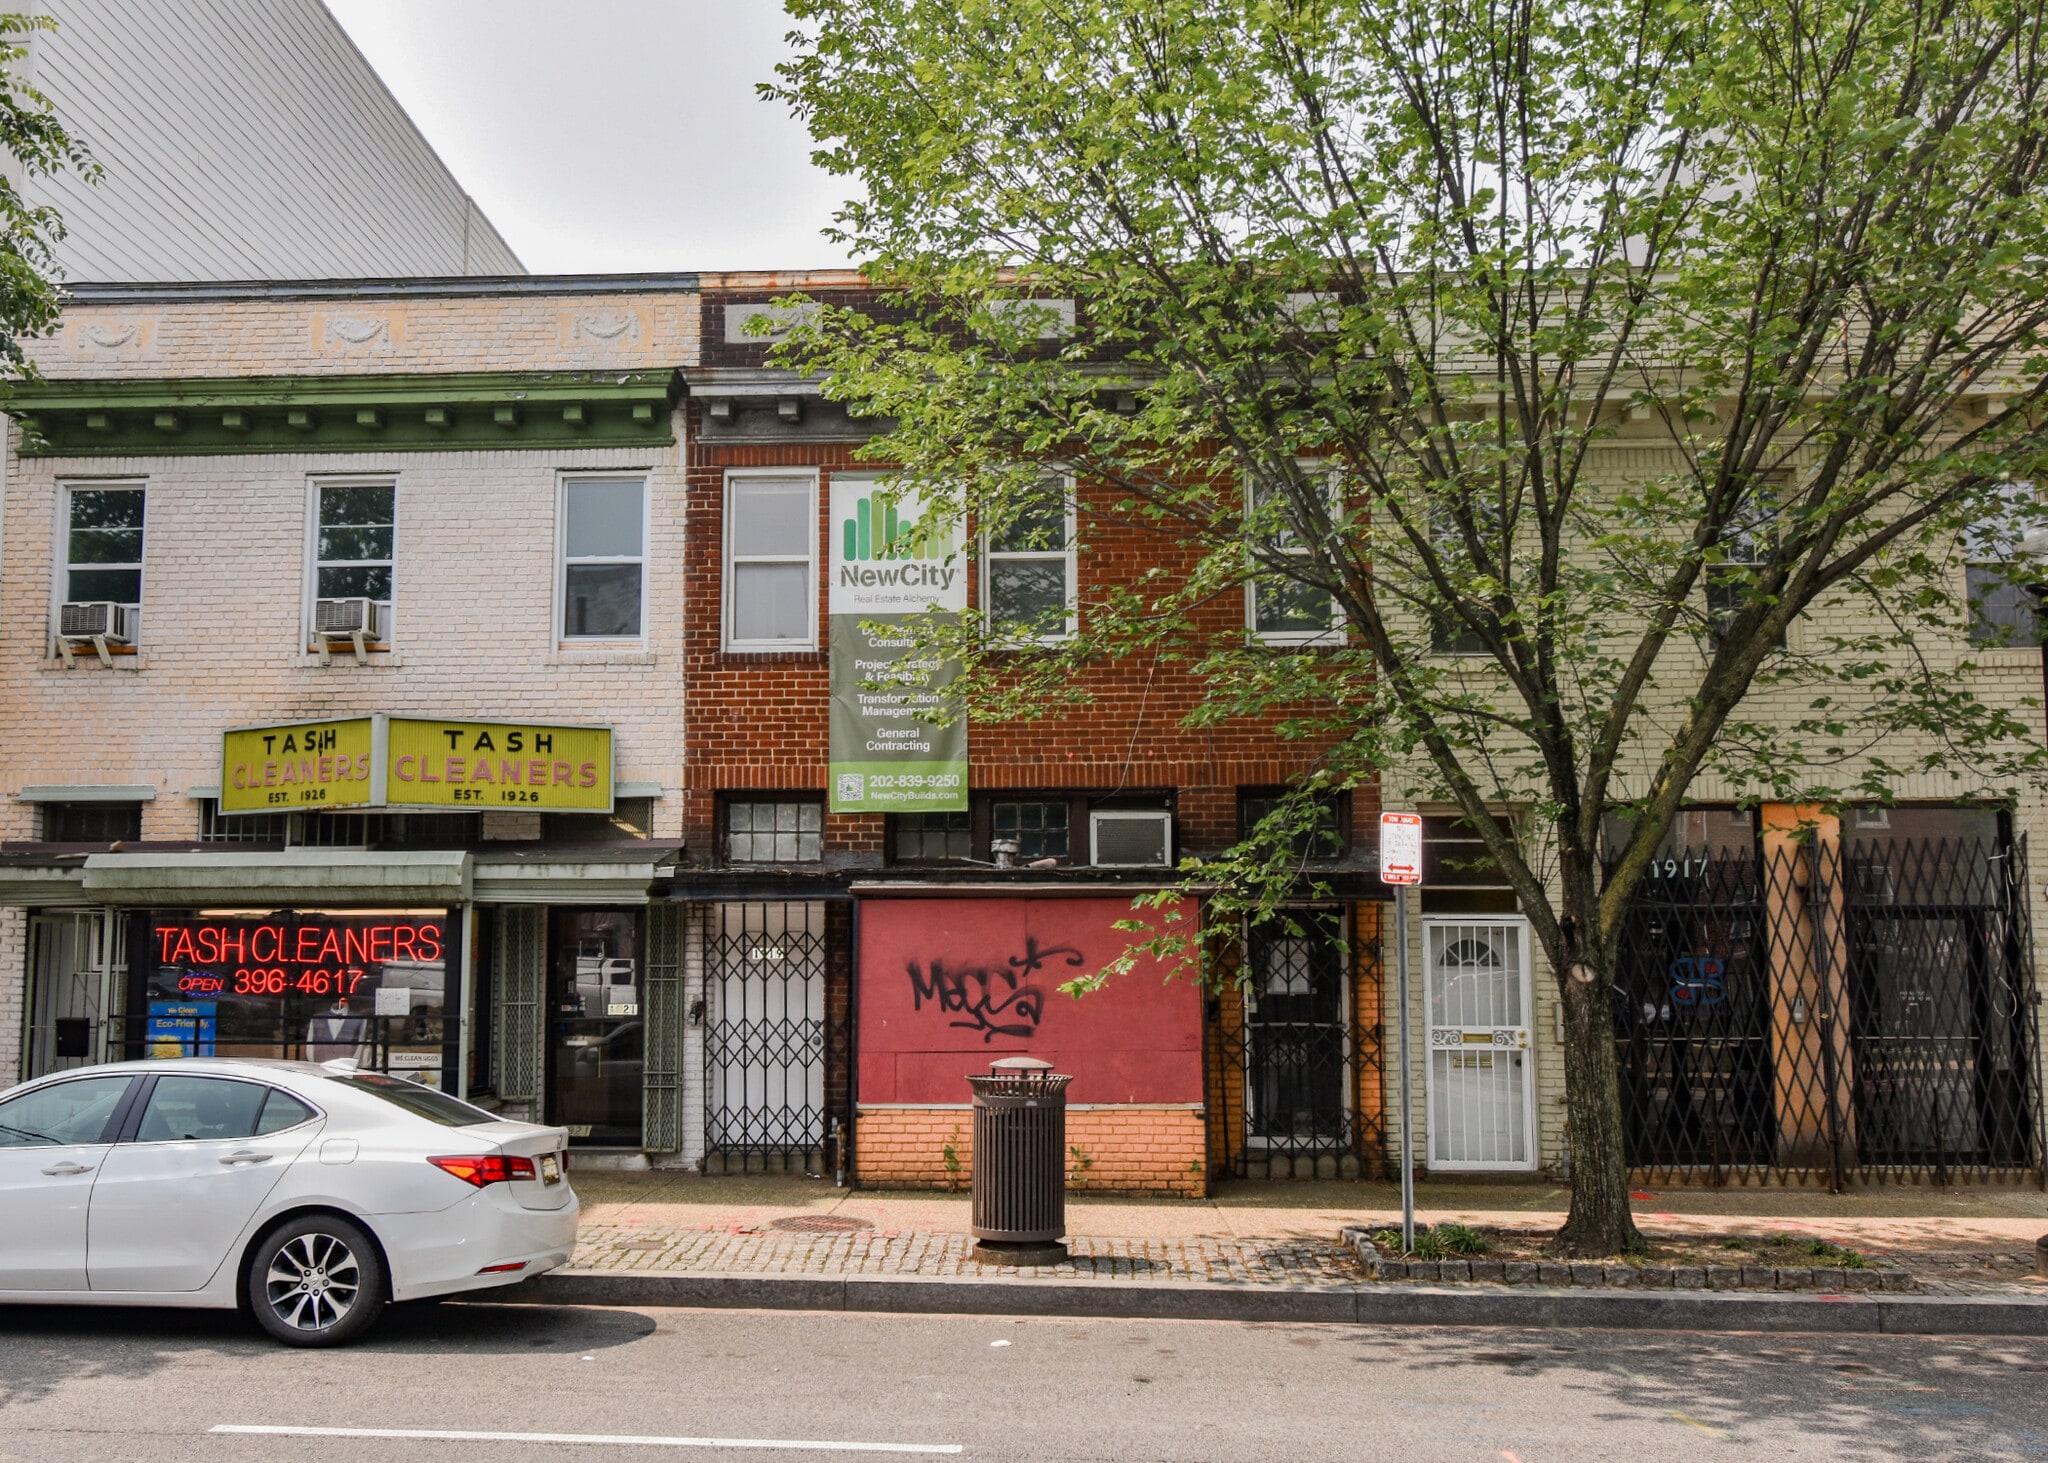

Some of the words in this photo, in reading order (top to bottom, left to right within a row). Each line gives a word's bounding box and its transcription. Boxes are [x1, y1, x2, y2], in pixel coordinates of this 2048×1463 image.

[841, 564, 956, 591] NewCity
[854, 594, 873, 603] Real
[874, 594, 901, 603] Estate
[903, 593, 940, 604] Alchemy
[868, 637, 926, 648] Consulti
[864, 672, 875, 682] &
[876, 728, 920, 738] General
[263, 729, 336, 755] TASH
[443, 730, 553, 753] TASH
[866, 740, 930, 752] Contracting
[232, 753, 370, 788] CLEANERS
[395, 755, 598, 788] CLEANERS
[869, 774, 960, 787] 202-839-9250
[268, 792, 289, 803] EST.
[300, 789, 326, 801] 1926
[454, 789, 484, 800] EST.
[501, 791, 539, 802] 1926
[870, 791, 958, 802] NewCityBuilds.com
[1651, 859, 1708, 878] 1917
[155, 926, 246, 964] TASH
[251, 925, 441, 964] CLEANERS
[178, 977, 224, 992] OPEN
[178, 1006, 198, 1014] Clean
[156, 1019, 210, 1029] Eco-Frienly.
